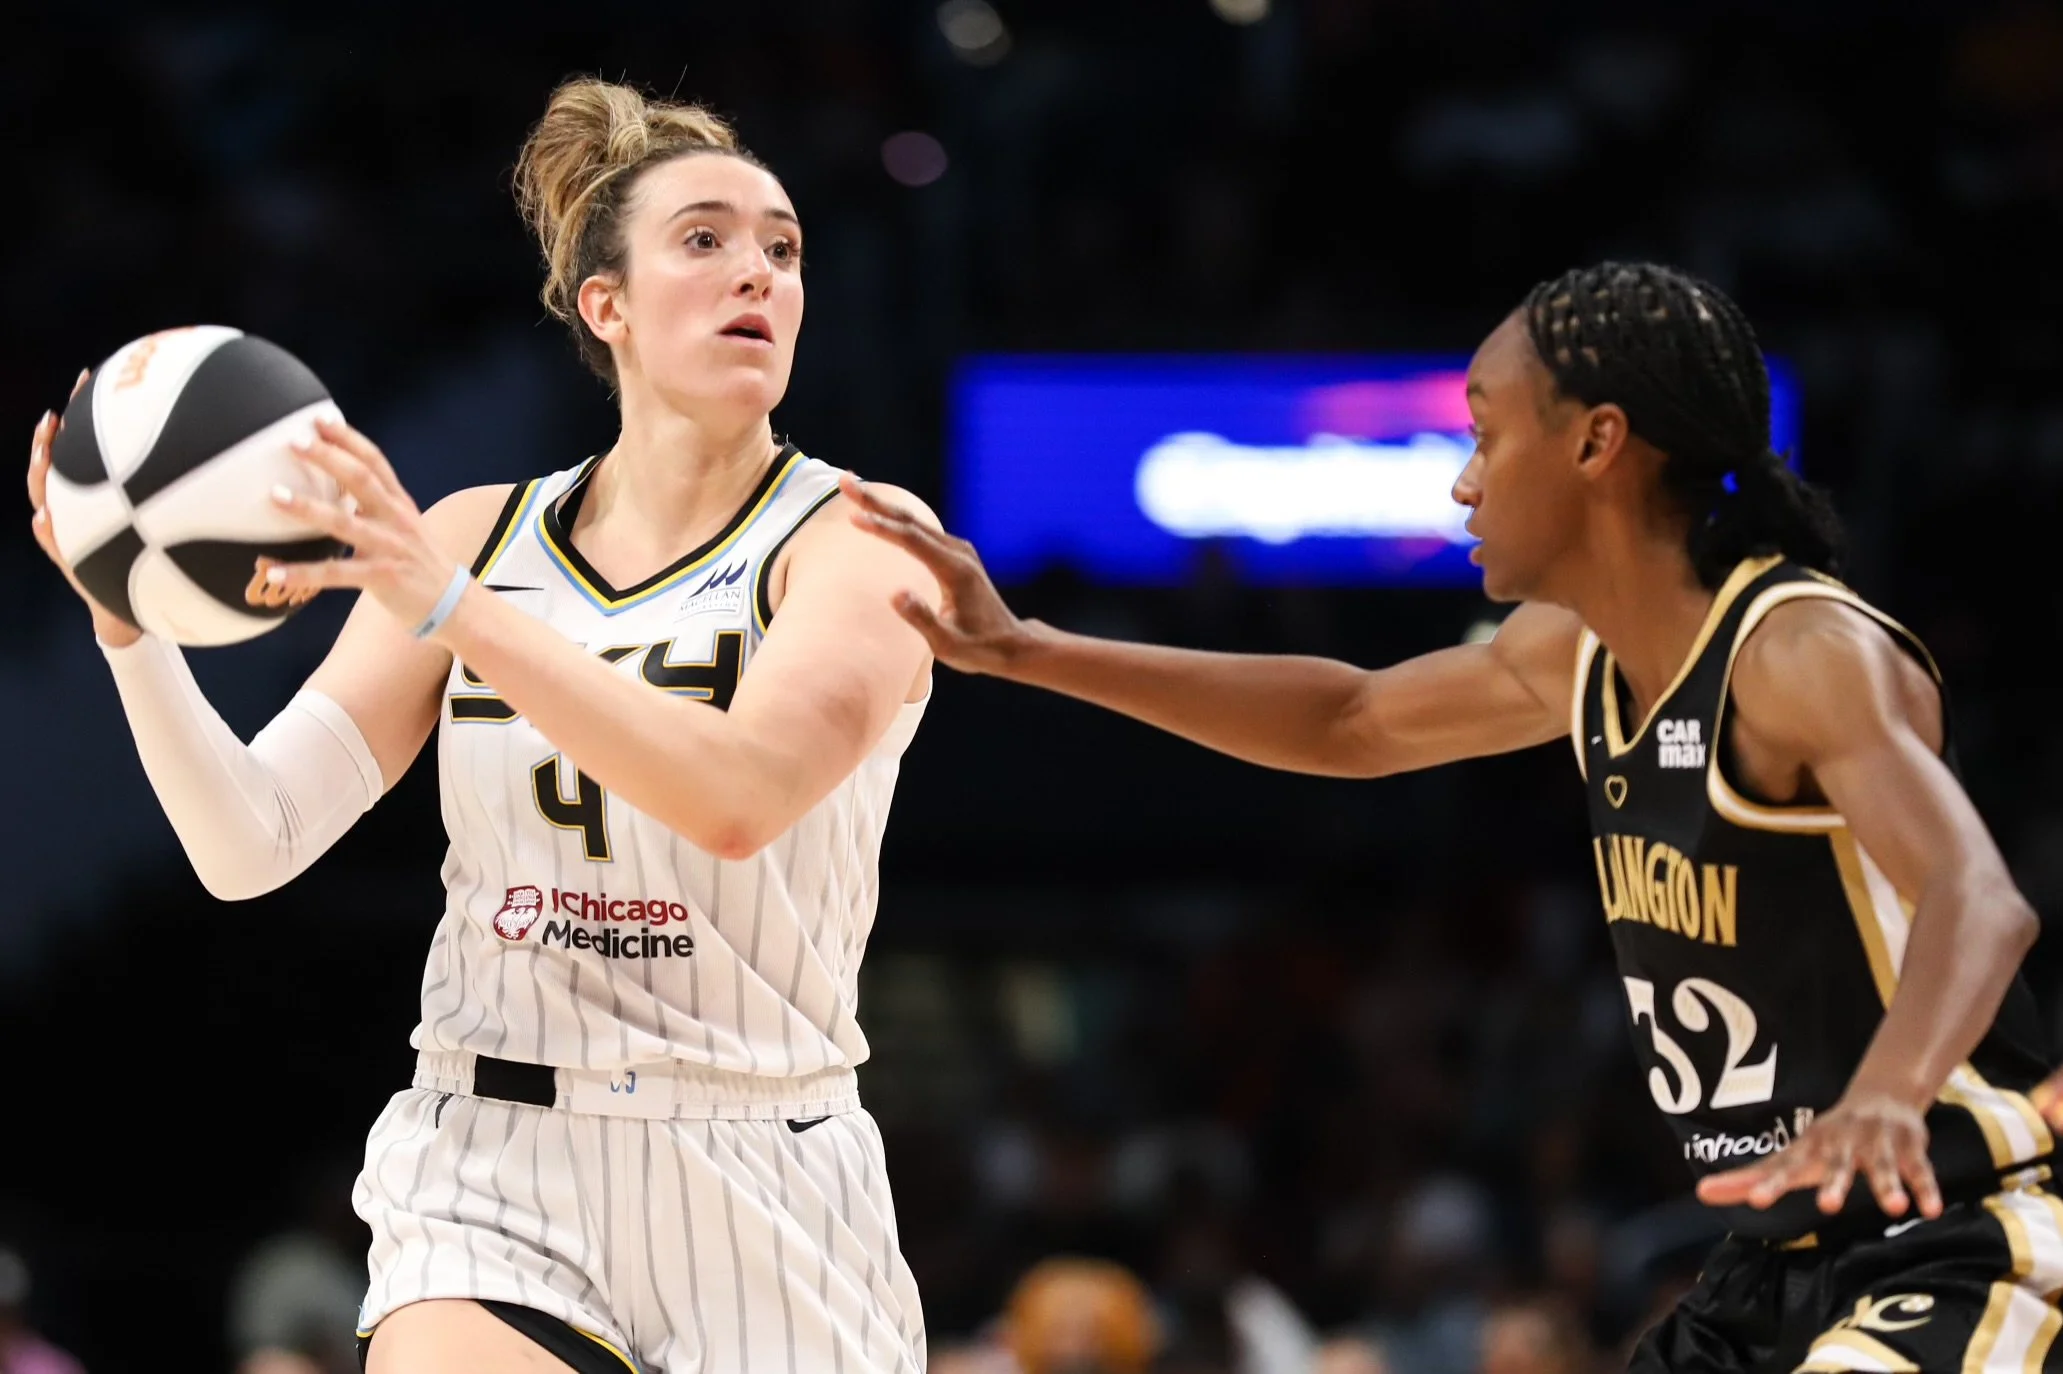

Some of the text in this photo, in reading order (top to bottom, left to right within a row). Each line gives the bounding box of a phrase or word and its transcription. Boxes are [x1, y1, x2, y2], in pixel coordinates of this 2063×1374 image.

[1656, 718, 1702, 744] CAR
[530, 752, 614, 864] 4
[541, 920, 695, 960] Medicine
[1623, 975, 1778, 1115] 32
